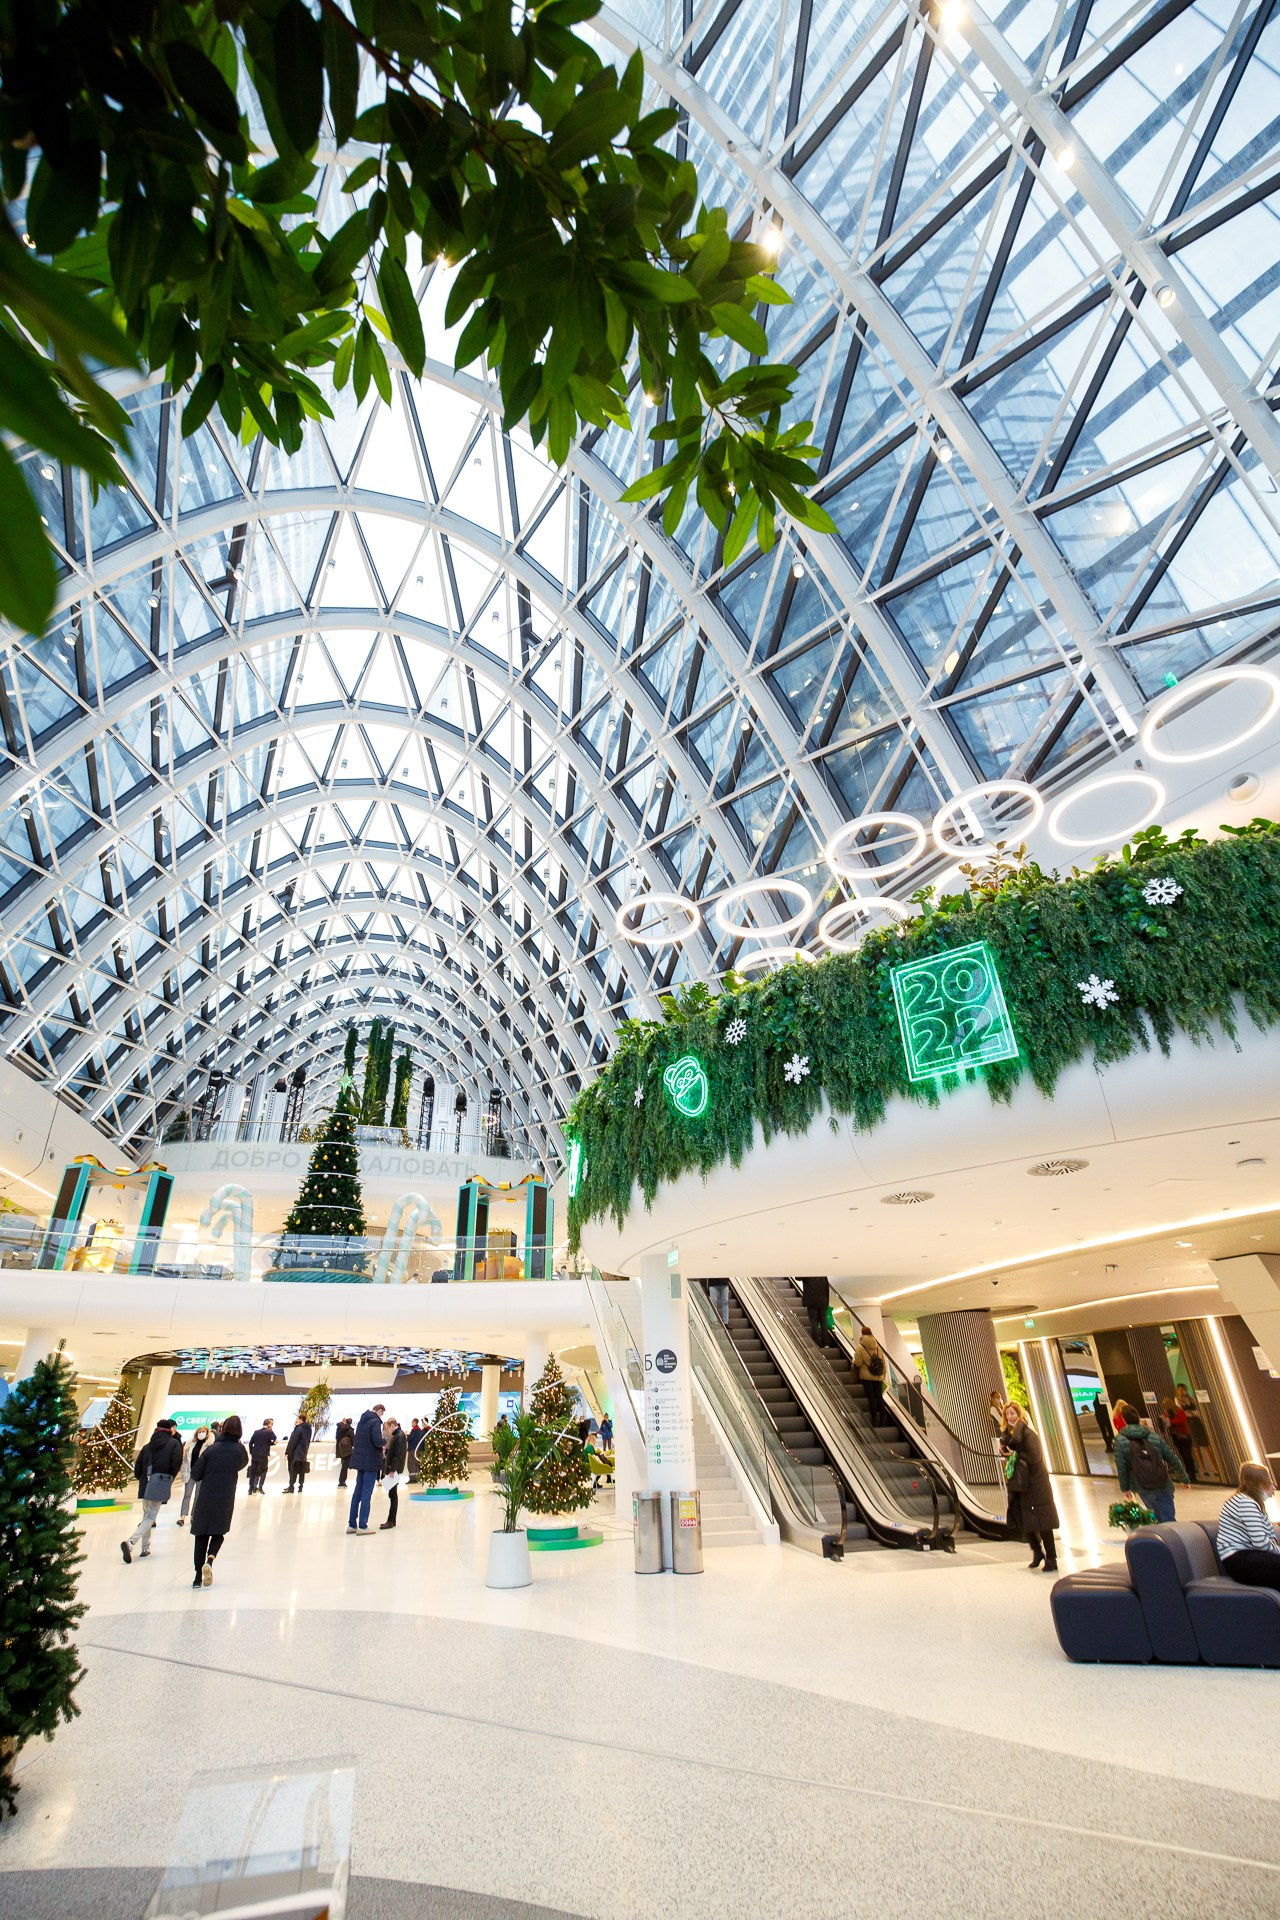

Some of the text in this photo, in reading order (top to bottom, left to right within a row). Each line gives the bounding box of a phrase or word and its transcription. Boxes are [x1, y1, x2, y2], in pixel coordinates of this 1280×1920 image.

[902, 957, 989, 1019] 20
[911, 1004, 1002, 1067] 22
[211, 1149, 477, 1178] ДОБРО АЛОВАТЬ
